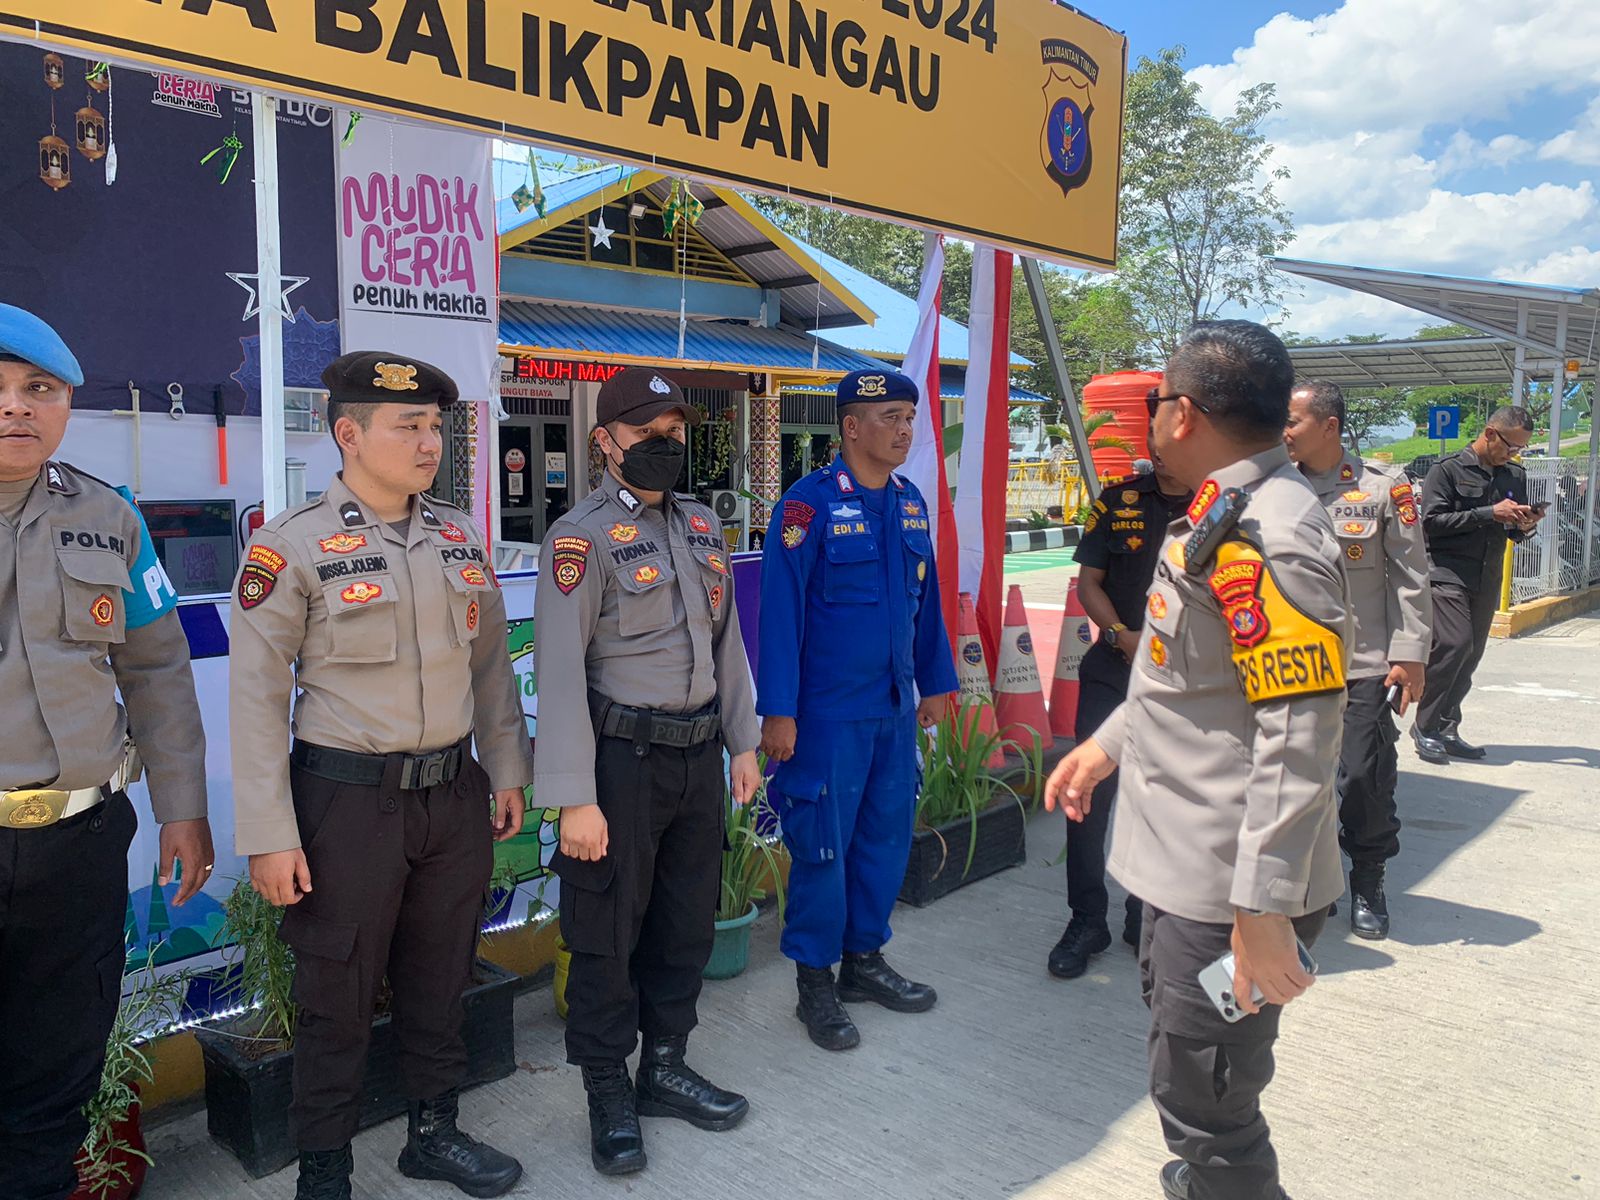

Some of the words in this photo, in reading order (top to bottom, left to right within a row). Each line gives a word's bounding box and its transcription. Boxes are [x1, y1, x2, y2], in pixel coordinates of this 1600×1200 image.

[1043, 45, 1080, 65] KALIMANTAN
[1080, 55, 1097, 81] TIMUR
[315, 0, 830, 169] BALIKPAPAN
[530, 389, 553, 397] BIAYA
[1436, 410, 1451, 436] P
[833, 524, 851, 535] EDI
[1111, 520, 1145, 531] CARLOS
[60, 531, 125, 555] POLRI
[687, 535, 723, 551] POLRI
[441, 547, 483, 563] POLRI
[1262, 641, 1336, 690] RESTA
